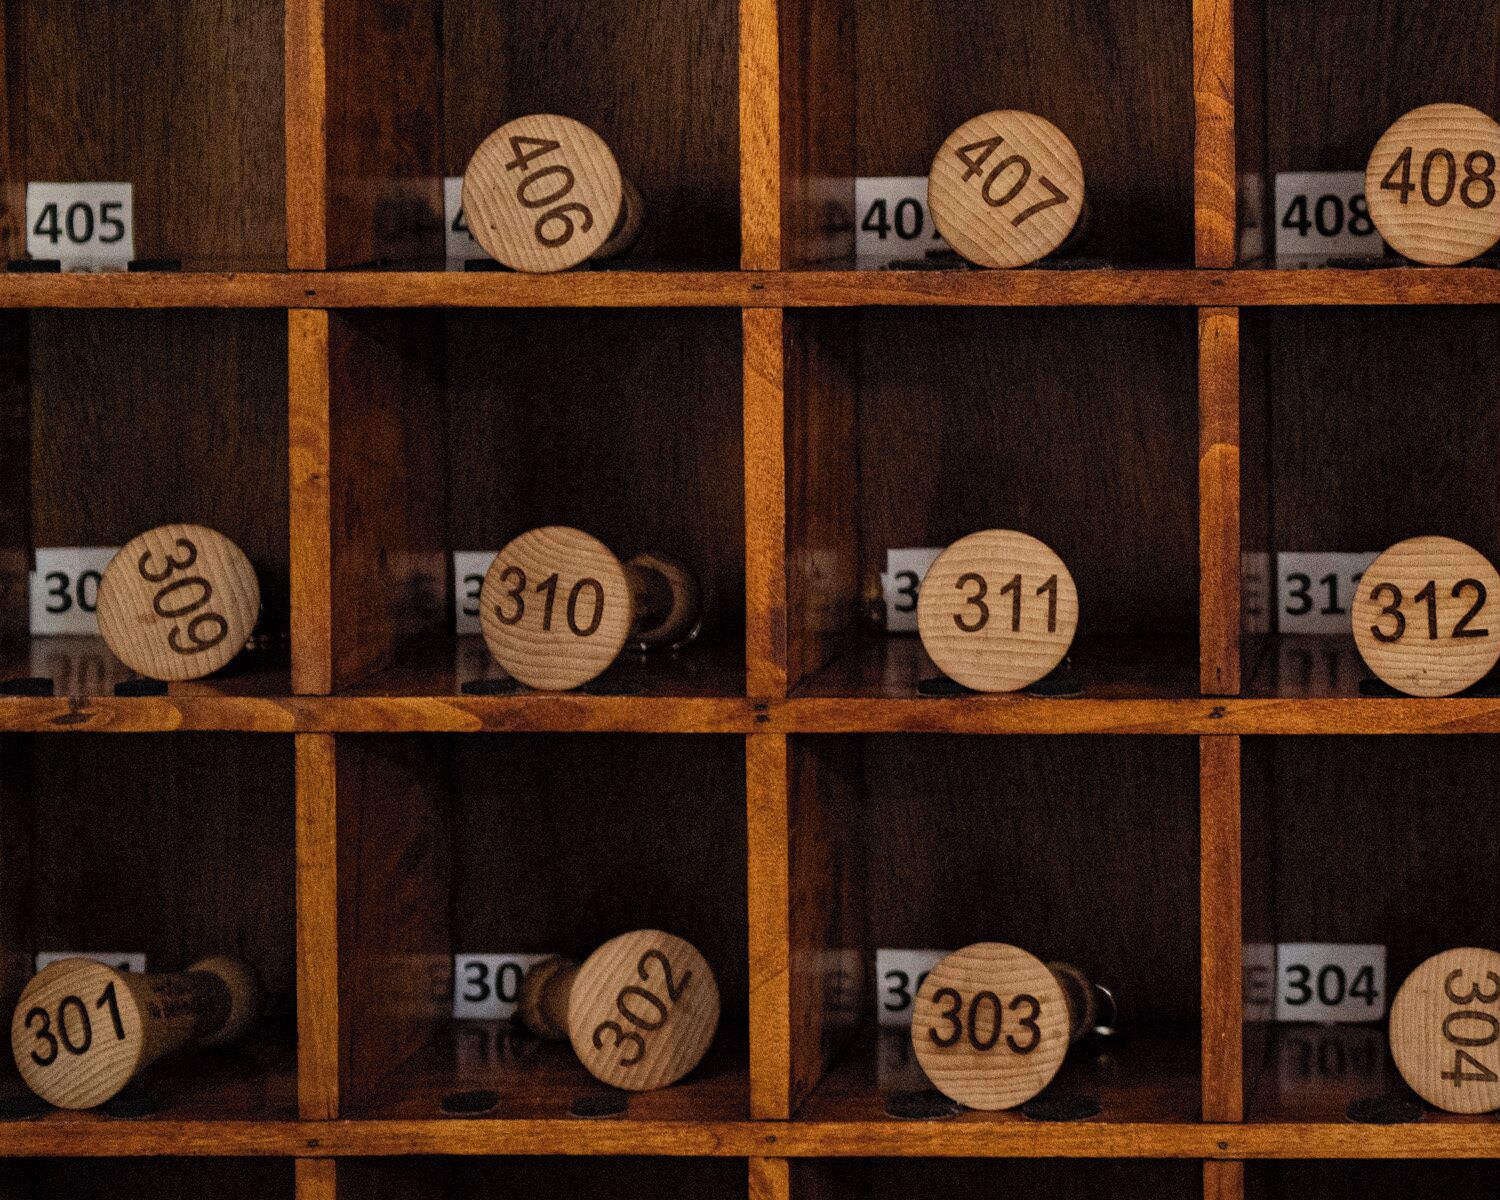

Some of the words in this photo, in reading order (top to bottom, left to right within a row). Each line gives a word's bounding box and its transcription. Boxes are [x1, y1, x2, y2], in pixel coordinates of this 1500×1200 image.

[503, 132, 594, 249] 406
[953, 133, 1071, 230] 407
[1379, 145, 1497, 210] 408
[32, 200, 127, 246] 405
[861, 197, 941, 241] 40
[1281, 193, 1377, 238] 408
[45, 570, 102, 614] 30
[137, 536, 230, 656] 309
[493, 565, 607, 638] 310
[952, 572, 1060, 634] 311
[1285, 571, 1364, 616] 31
[1368, 577, 1490, 644] 312
[462, 961, 525, 1004] 30
[591, 947, 694, 1069] 302
[1283, 963, 1380, 1007] 304
[23, 979, 128, 1068] 301
[927, 986, 1042, 1056] 303
